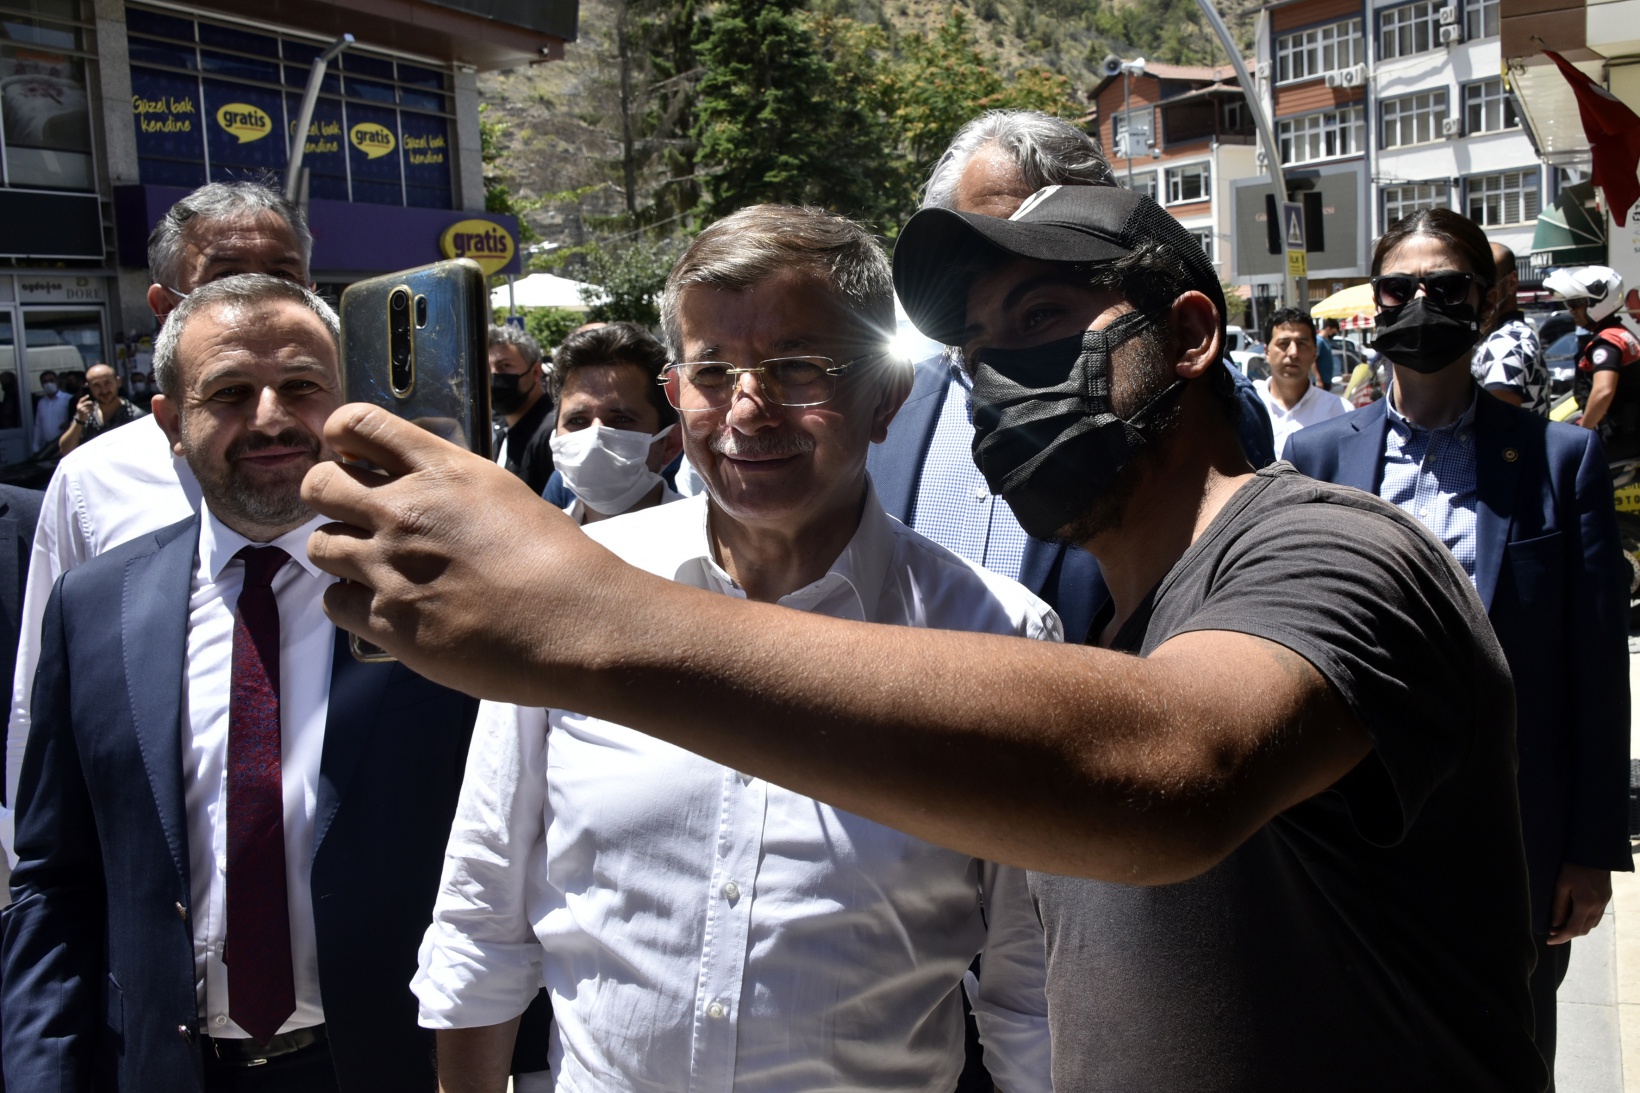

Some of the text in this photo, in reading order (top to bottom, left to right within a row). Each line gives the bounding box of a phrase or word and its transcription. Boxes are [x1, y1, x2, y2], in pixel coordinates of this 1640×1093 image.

[132, 95, 195, 114] Güzel bak
[141, 115, 191, 132] kendine
[223, 110, 266, 128] gratis
[321, 121, 341, 136] bak
[355, 129, 390, 145] gratis
[429, 134, 446, 148] bak
[304, 138, 338, 153] endine
[409, 149, 443, 164] kendine
[453, 227, 507, 258] gratis
